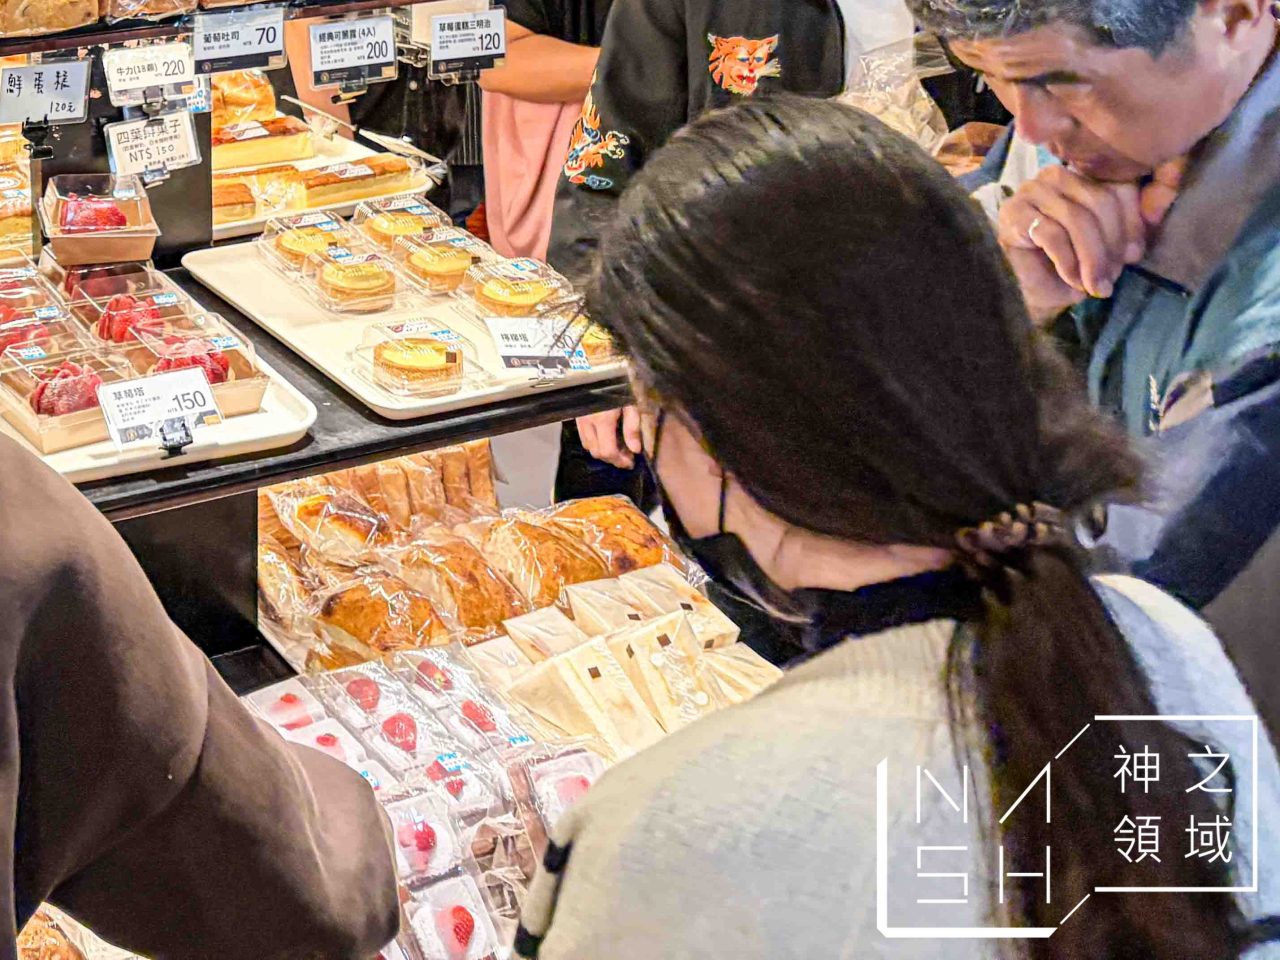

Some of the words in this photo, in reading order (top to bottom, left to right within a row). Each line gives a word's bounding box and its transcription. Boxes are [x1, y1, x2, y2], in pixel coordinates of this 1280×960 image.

[438, 19, 492, 32] 草莓蛋糕三明治
[203, 30, 240, 44] 葡萄吐司
[255, 26, 277, 45] 70
[479, 32, 500, 51] 120
[366, 40, 388, 59] 200
[162, 58, 185, 77] 220
[129, 147, 153, 163] NT$
[156, 144, 175, 156] 150
[172, 390, 207, 412] 150
